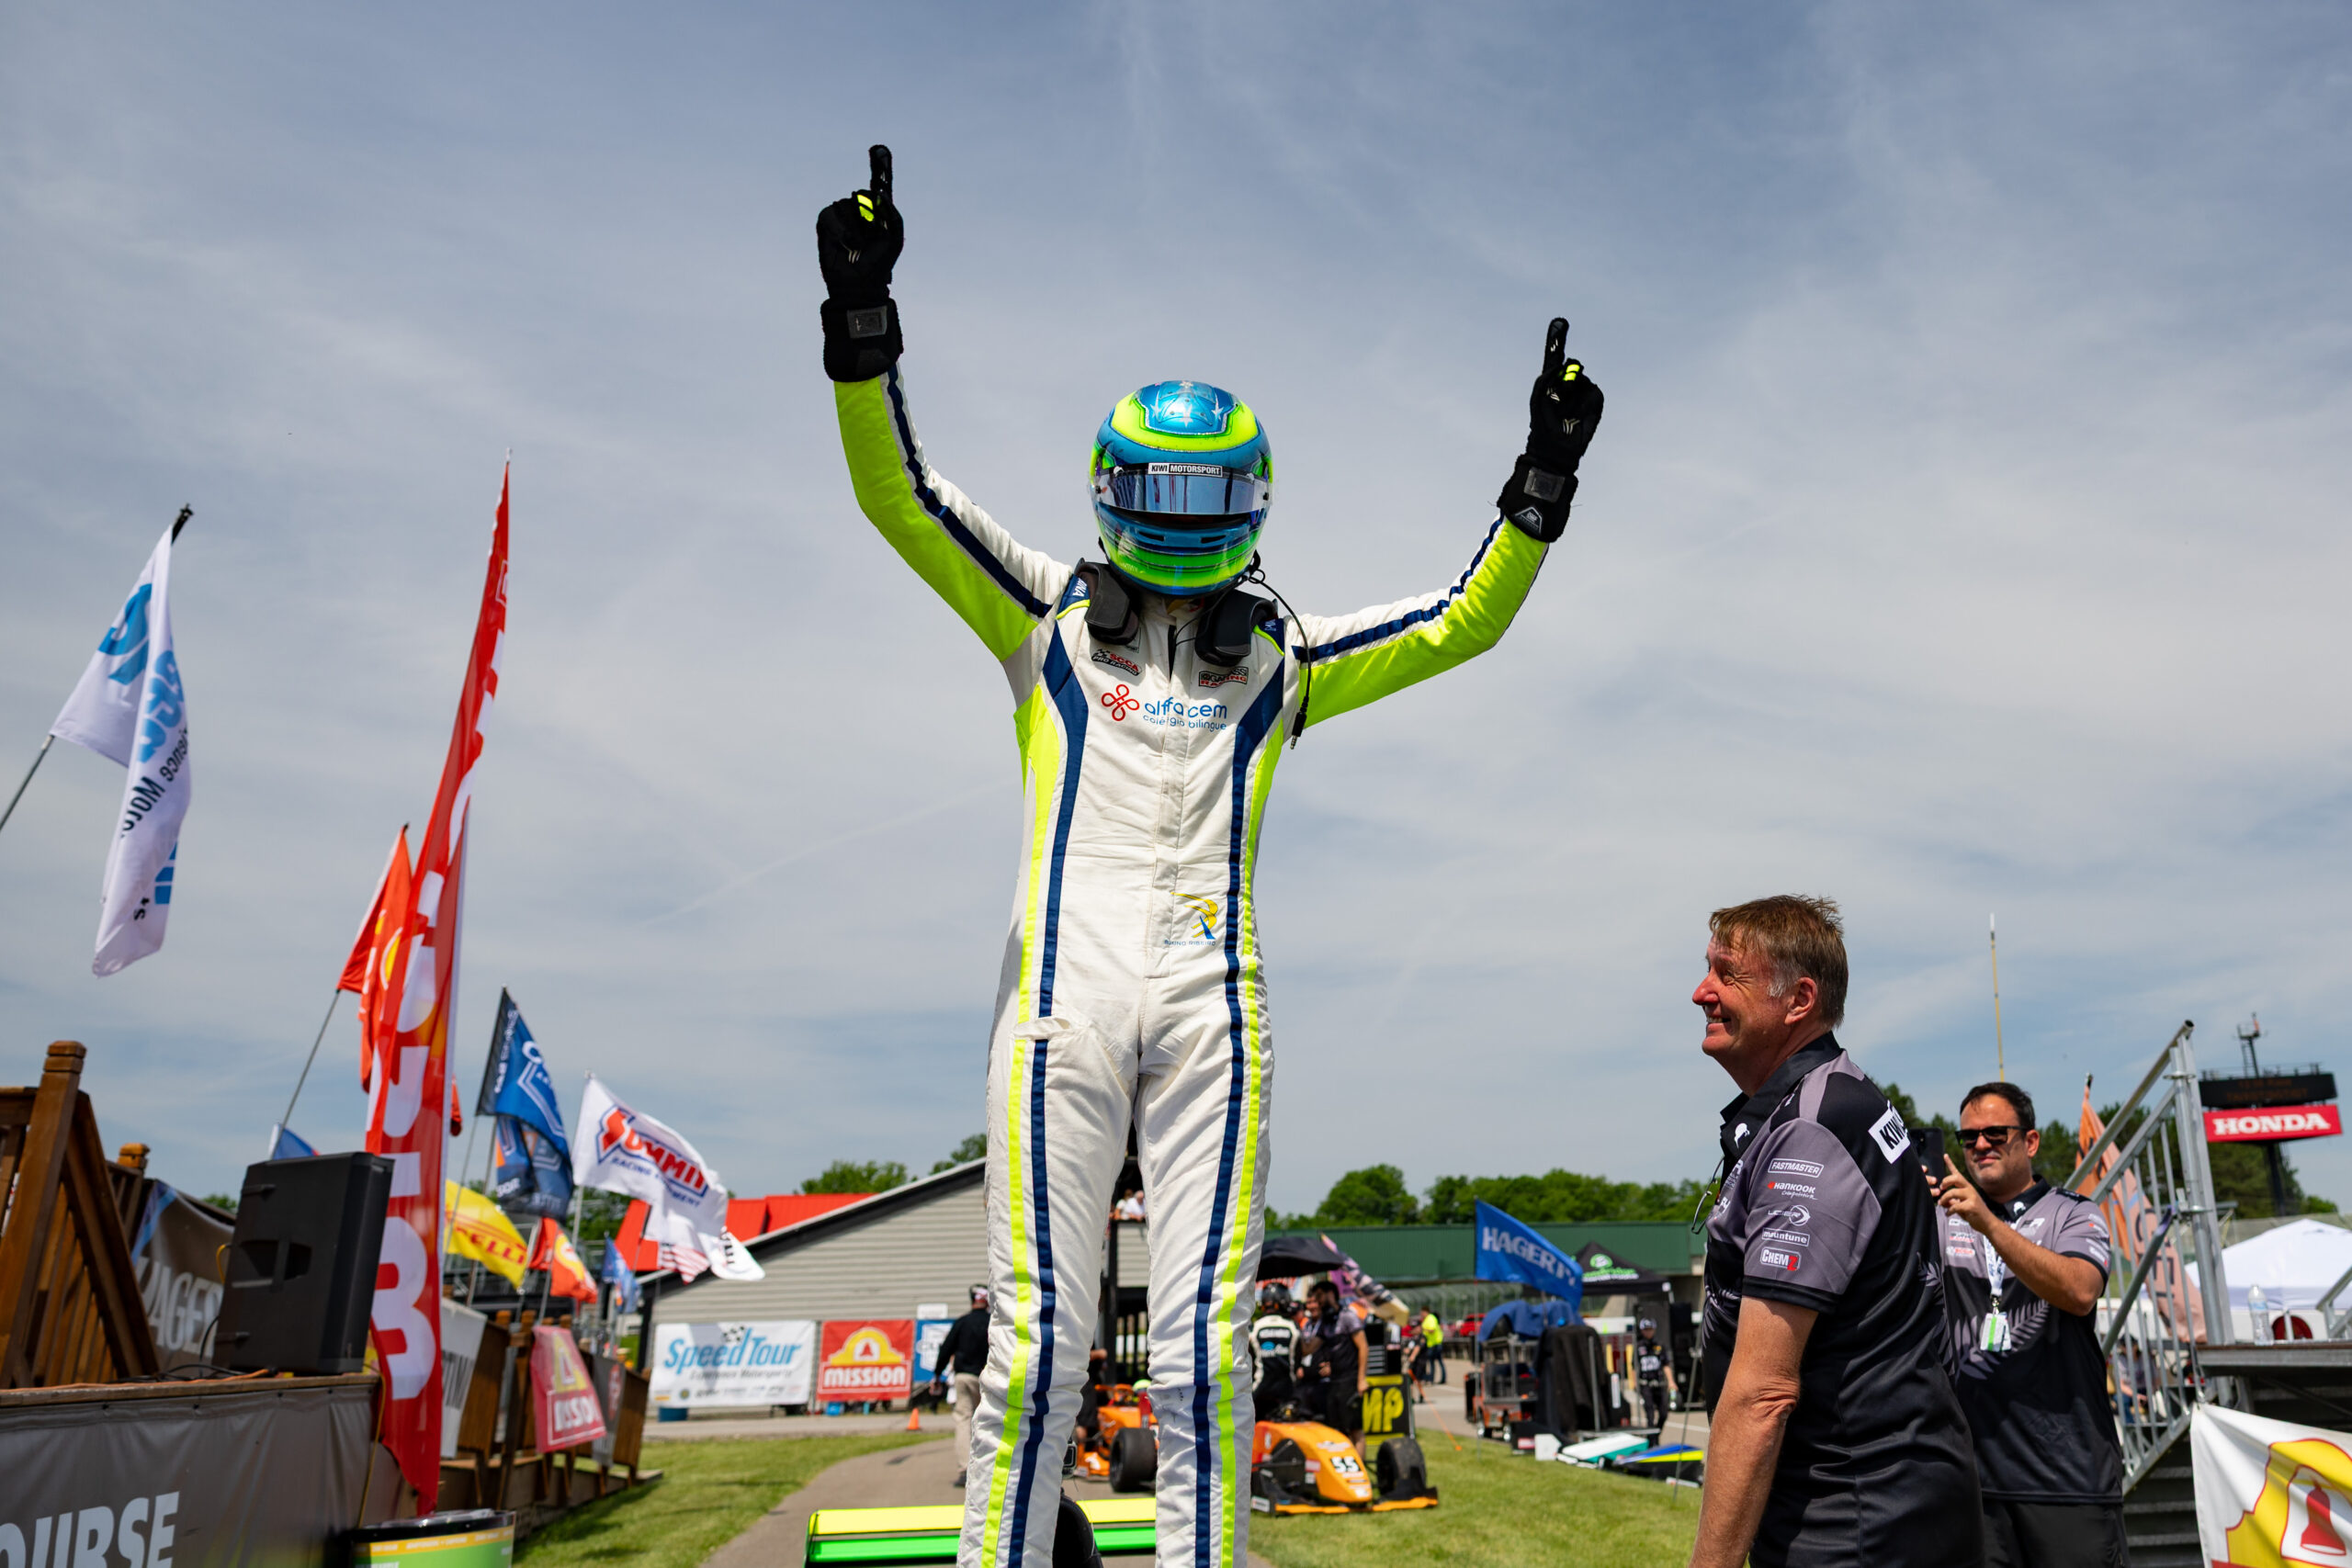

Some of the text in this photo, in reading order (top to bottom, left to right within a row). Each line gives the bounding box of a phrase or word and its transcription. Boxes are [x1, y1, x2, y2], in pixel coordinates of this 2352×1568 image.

[1151, 464, 1220, 475] KIWI MOTORSPORT
[1110, 653, 1138, 671] SCCA
[1110, 660, 1137, 675] RACING
[2212, 1112, 2332, 1135] HONDA
[1771, 1161, 1820, 1175] FASTMASTER
[1332, 1456, 1361, 1473] 55
